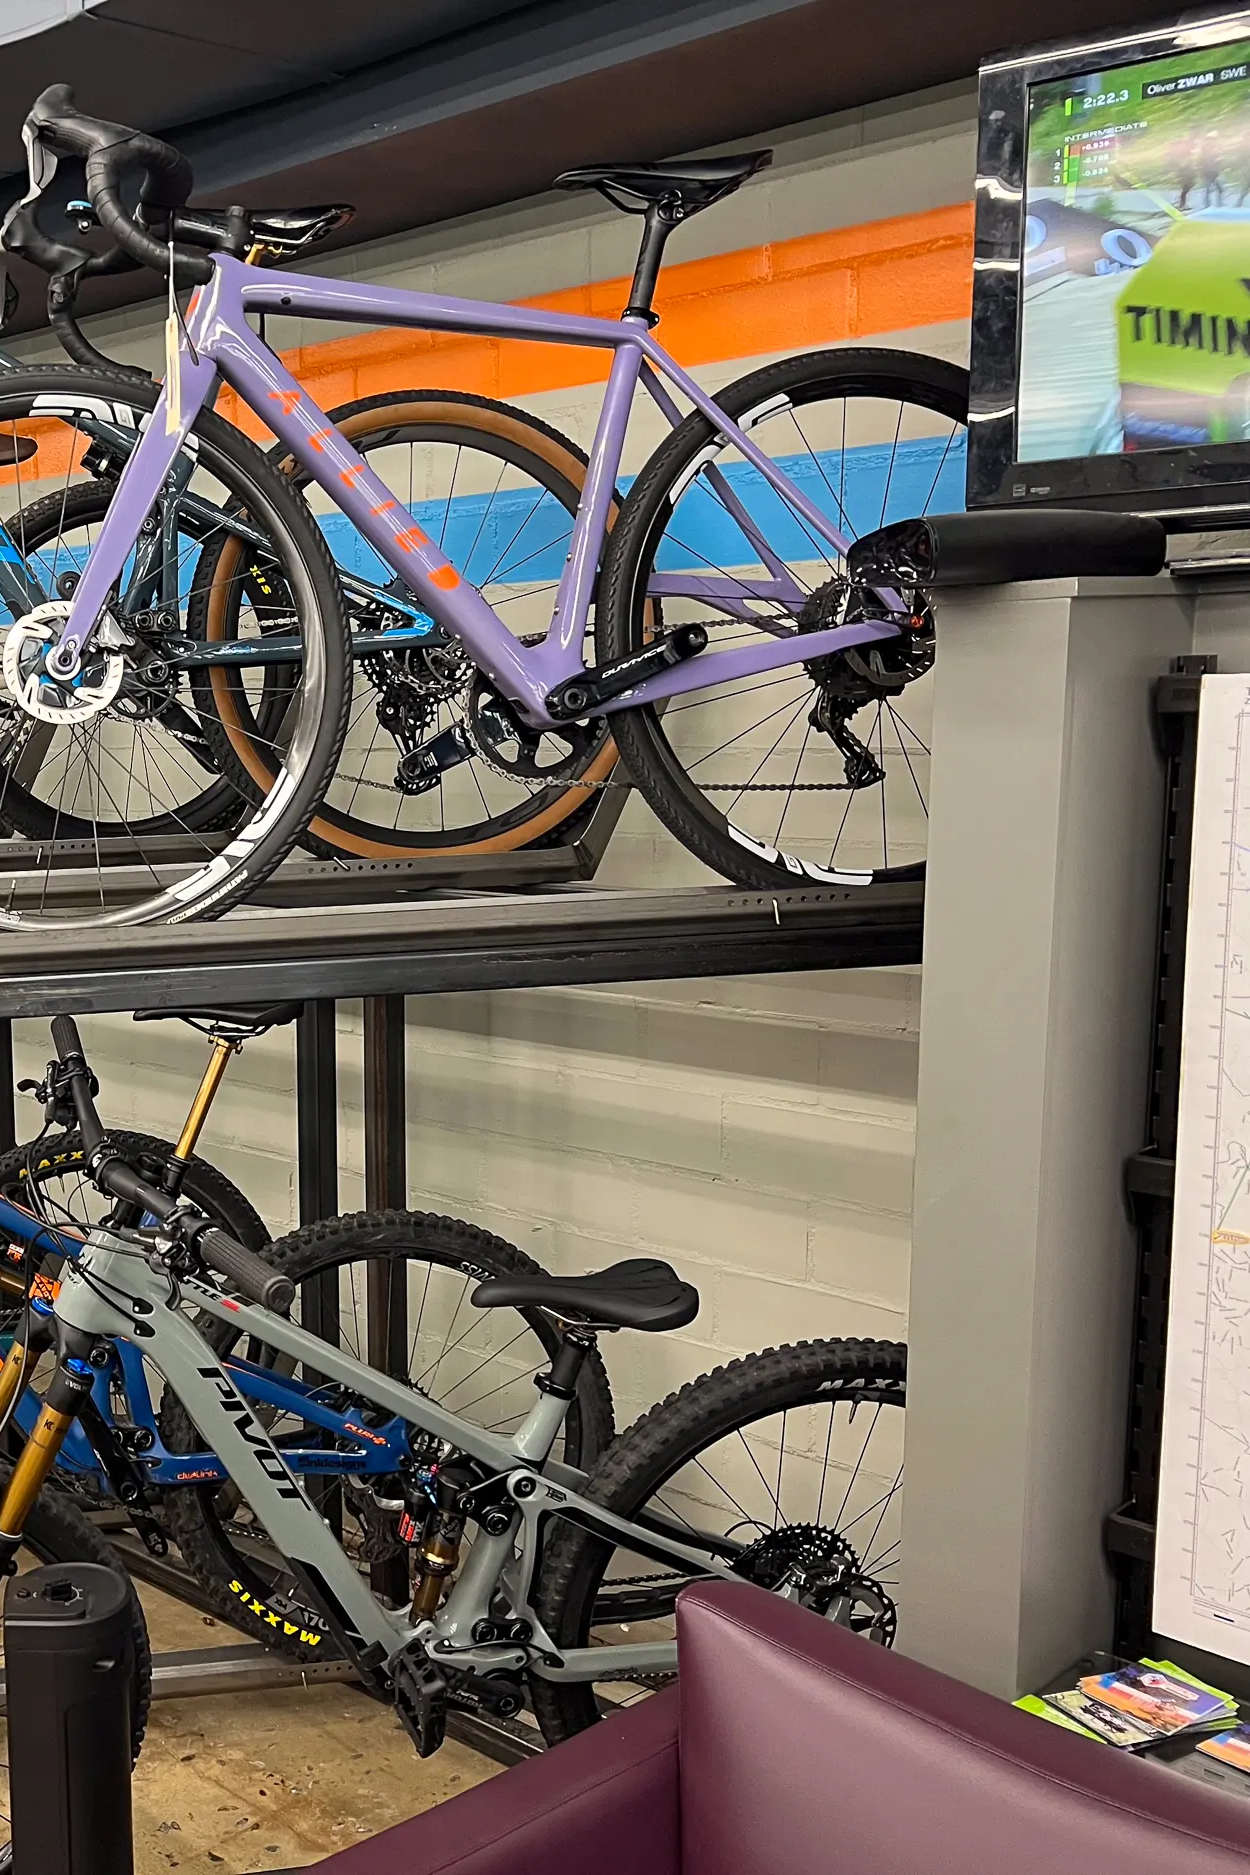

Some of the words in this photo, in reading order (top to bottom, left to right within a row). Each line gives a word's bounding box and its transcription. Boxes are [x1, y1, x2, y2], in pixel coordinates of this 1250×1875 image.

[1147, 81, 1176, 95] Oliver
[1177, 72, 1214, 90] ZWAR
[1220, 65, 1247, 81] SWE
[1083, 89, 1130, 109] 2:22.3
[1064, 121, 1148, 142] INTERMEDIATE
[1055, 148, 1062, 157] 1
[1054, 161, 1061, 171] 2
[1053, 174, 1061, 184] 3
[267, 391, 460, 592] ALLIED
[196, 1367, 311, 1512] PIVOT
[228, 1579, 322, 1647] MAXXIS
[302, 1611, 331, 1632] 170
